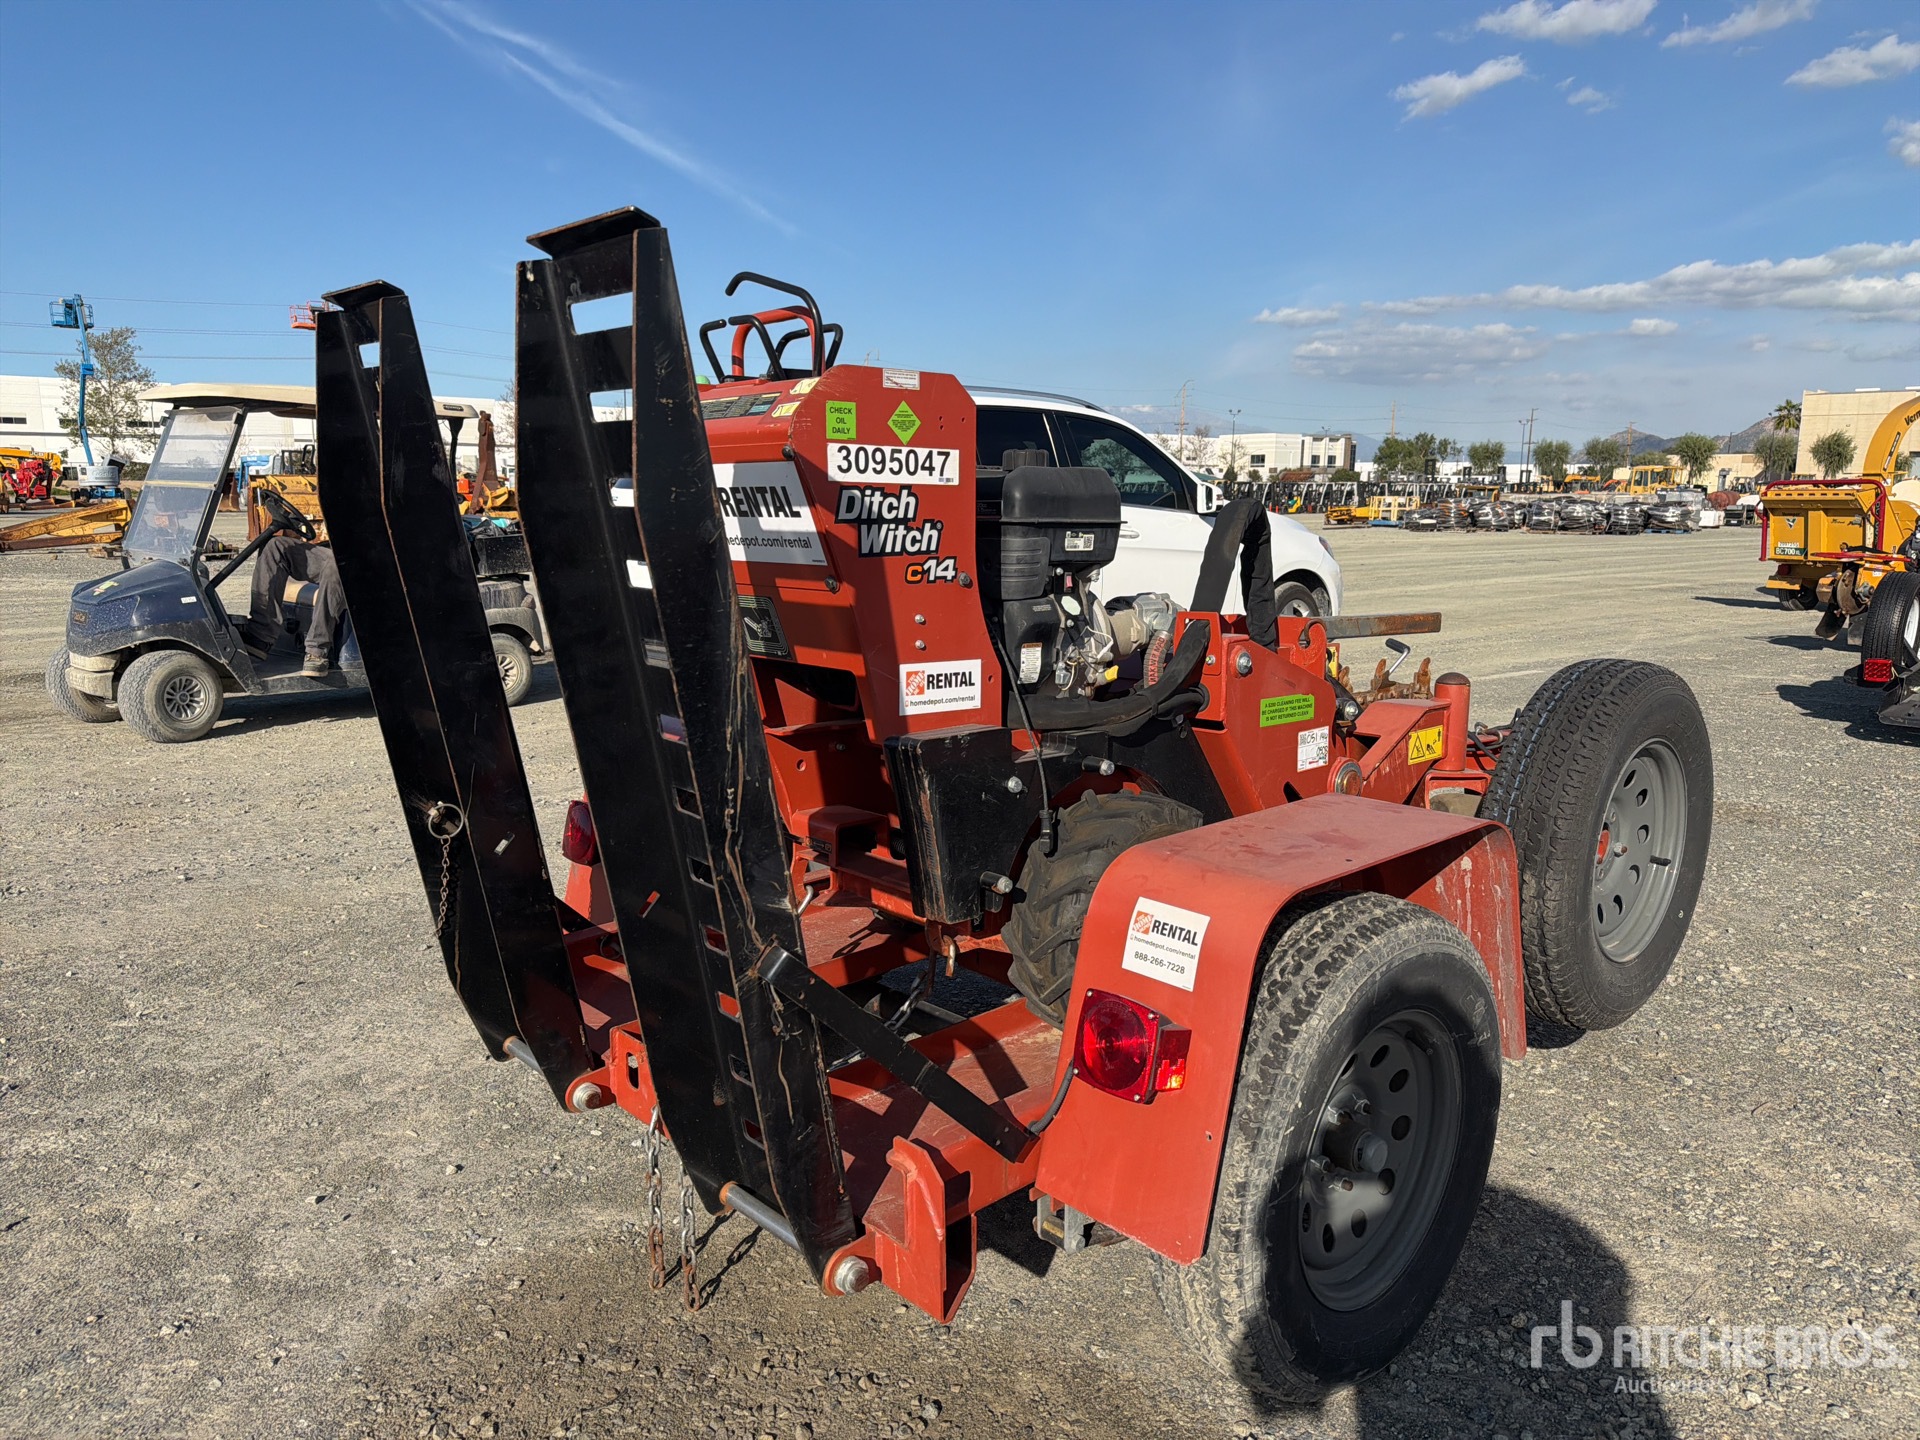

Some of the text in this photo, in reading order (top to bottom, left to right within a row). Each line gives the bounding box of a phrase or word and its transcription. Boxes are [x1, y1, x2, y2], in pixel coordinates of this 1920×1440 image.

[829, 406, 853, 415] CHECK
[835, 417, 847, 425] OIL
[832, 427, 851, 435] DAILY
[837, 445, 951, 477] 3095047
[717, 485, 802, 518] RENTAL
[837, 488, 917, 521] Ditch
[860, 521, 939, 555] Witch
[926, 671, 975, 690] RENTAL
[909, 695, 976, 706] homedepot.com/rental
[1267, 707, 1285, 715] CHARGED
[1278, 712, 1297, 720] RETURNED
[1151, 919, 1199, 946] RENTAL
[1133, 935, 1196, 960] homedepot.com/rental
[1134, 951, 1186, 975] 888-266-7228
